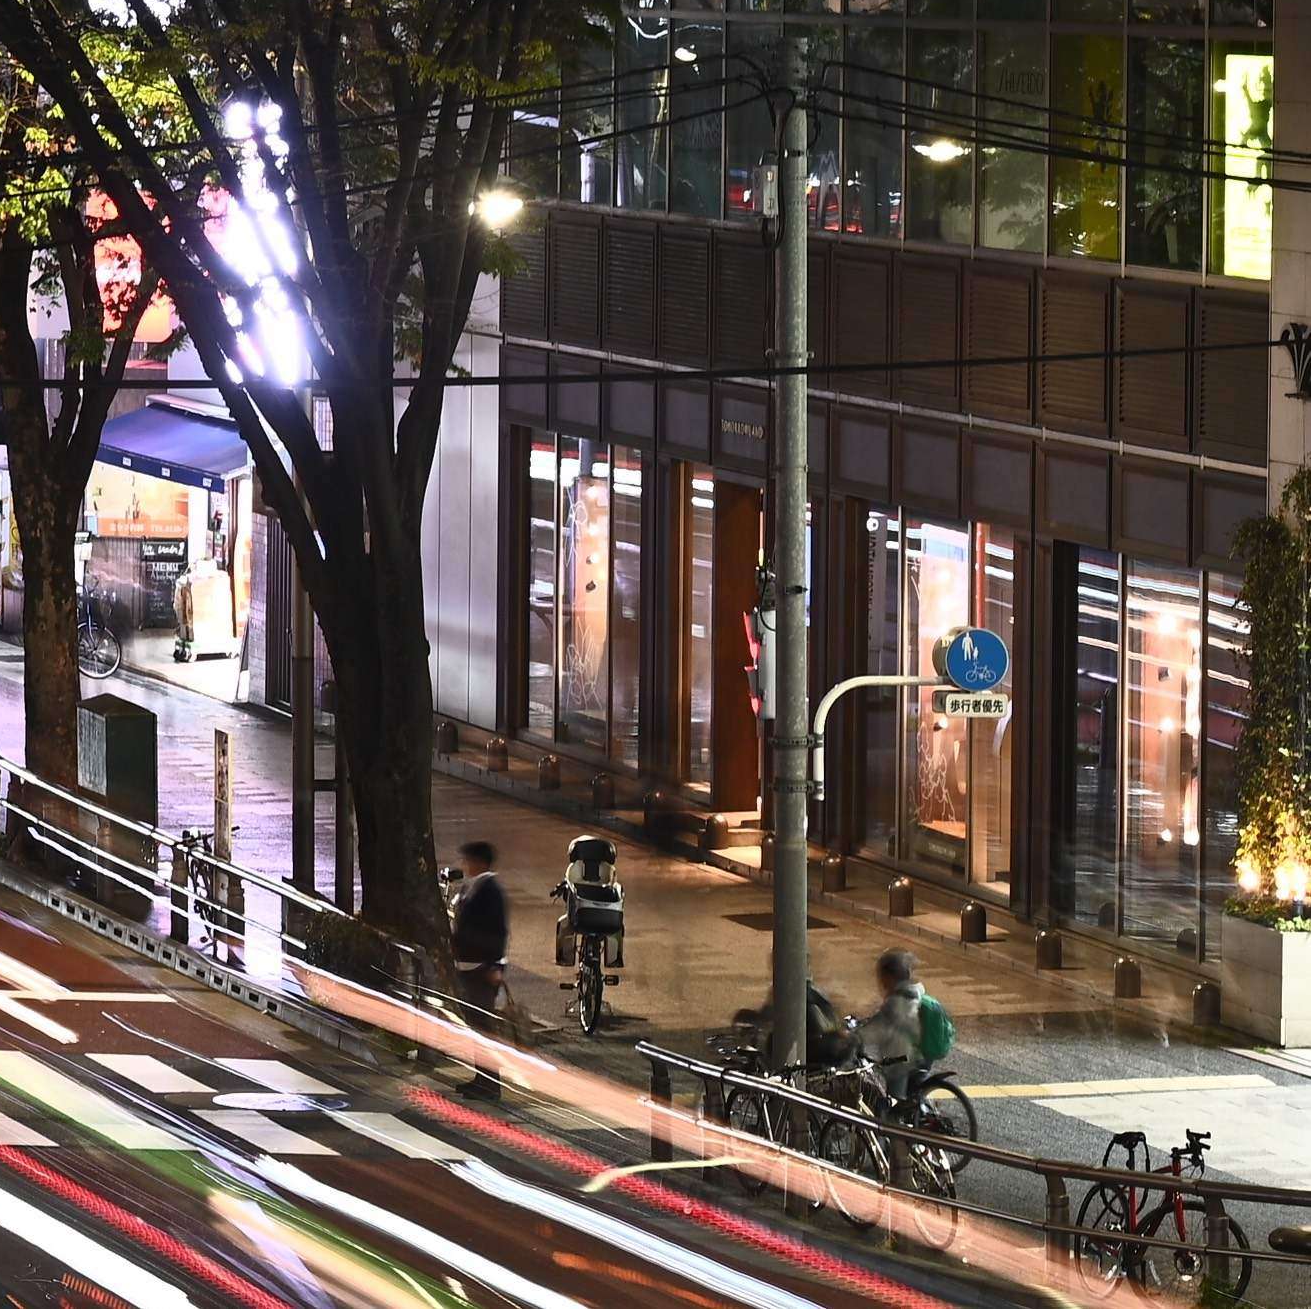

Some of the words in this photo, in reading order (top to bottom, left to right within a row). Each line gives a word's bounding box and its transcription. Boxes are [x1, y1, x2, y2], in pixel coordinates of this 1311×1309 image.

[949, 699, 1004, 714] 歩行者優先
